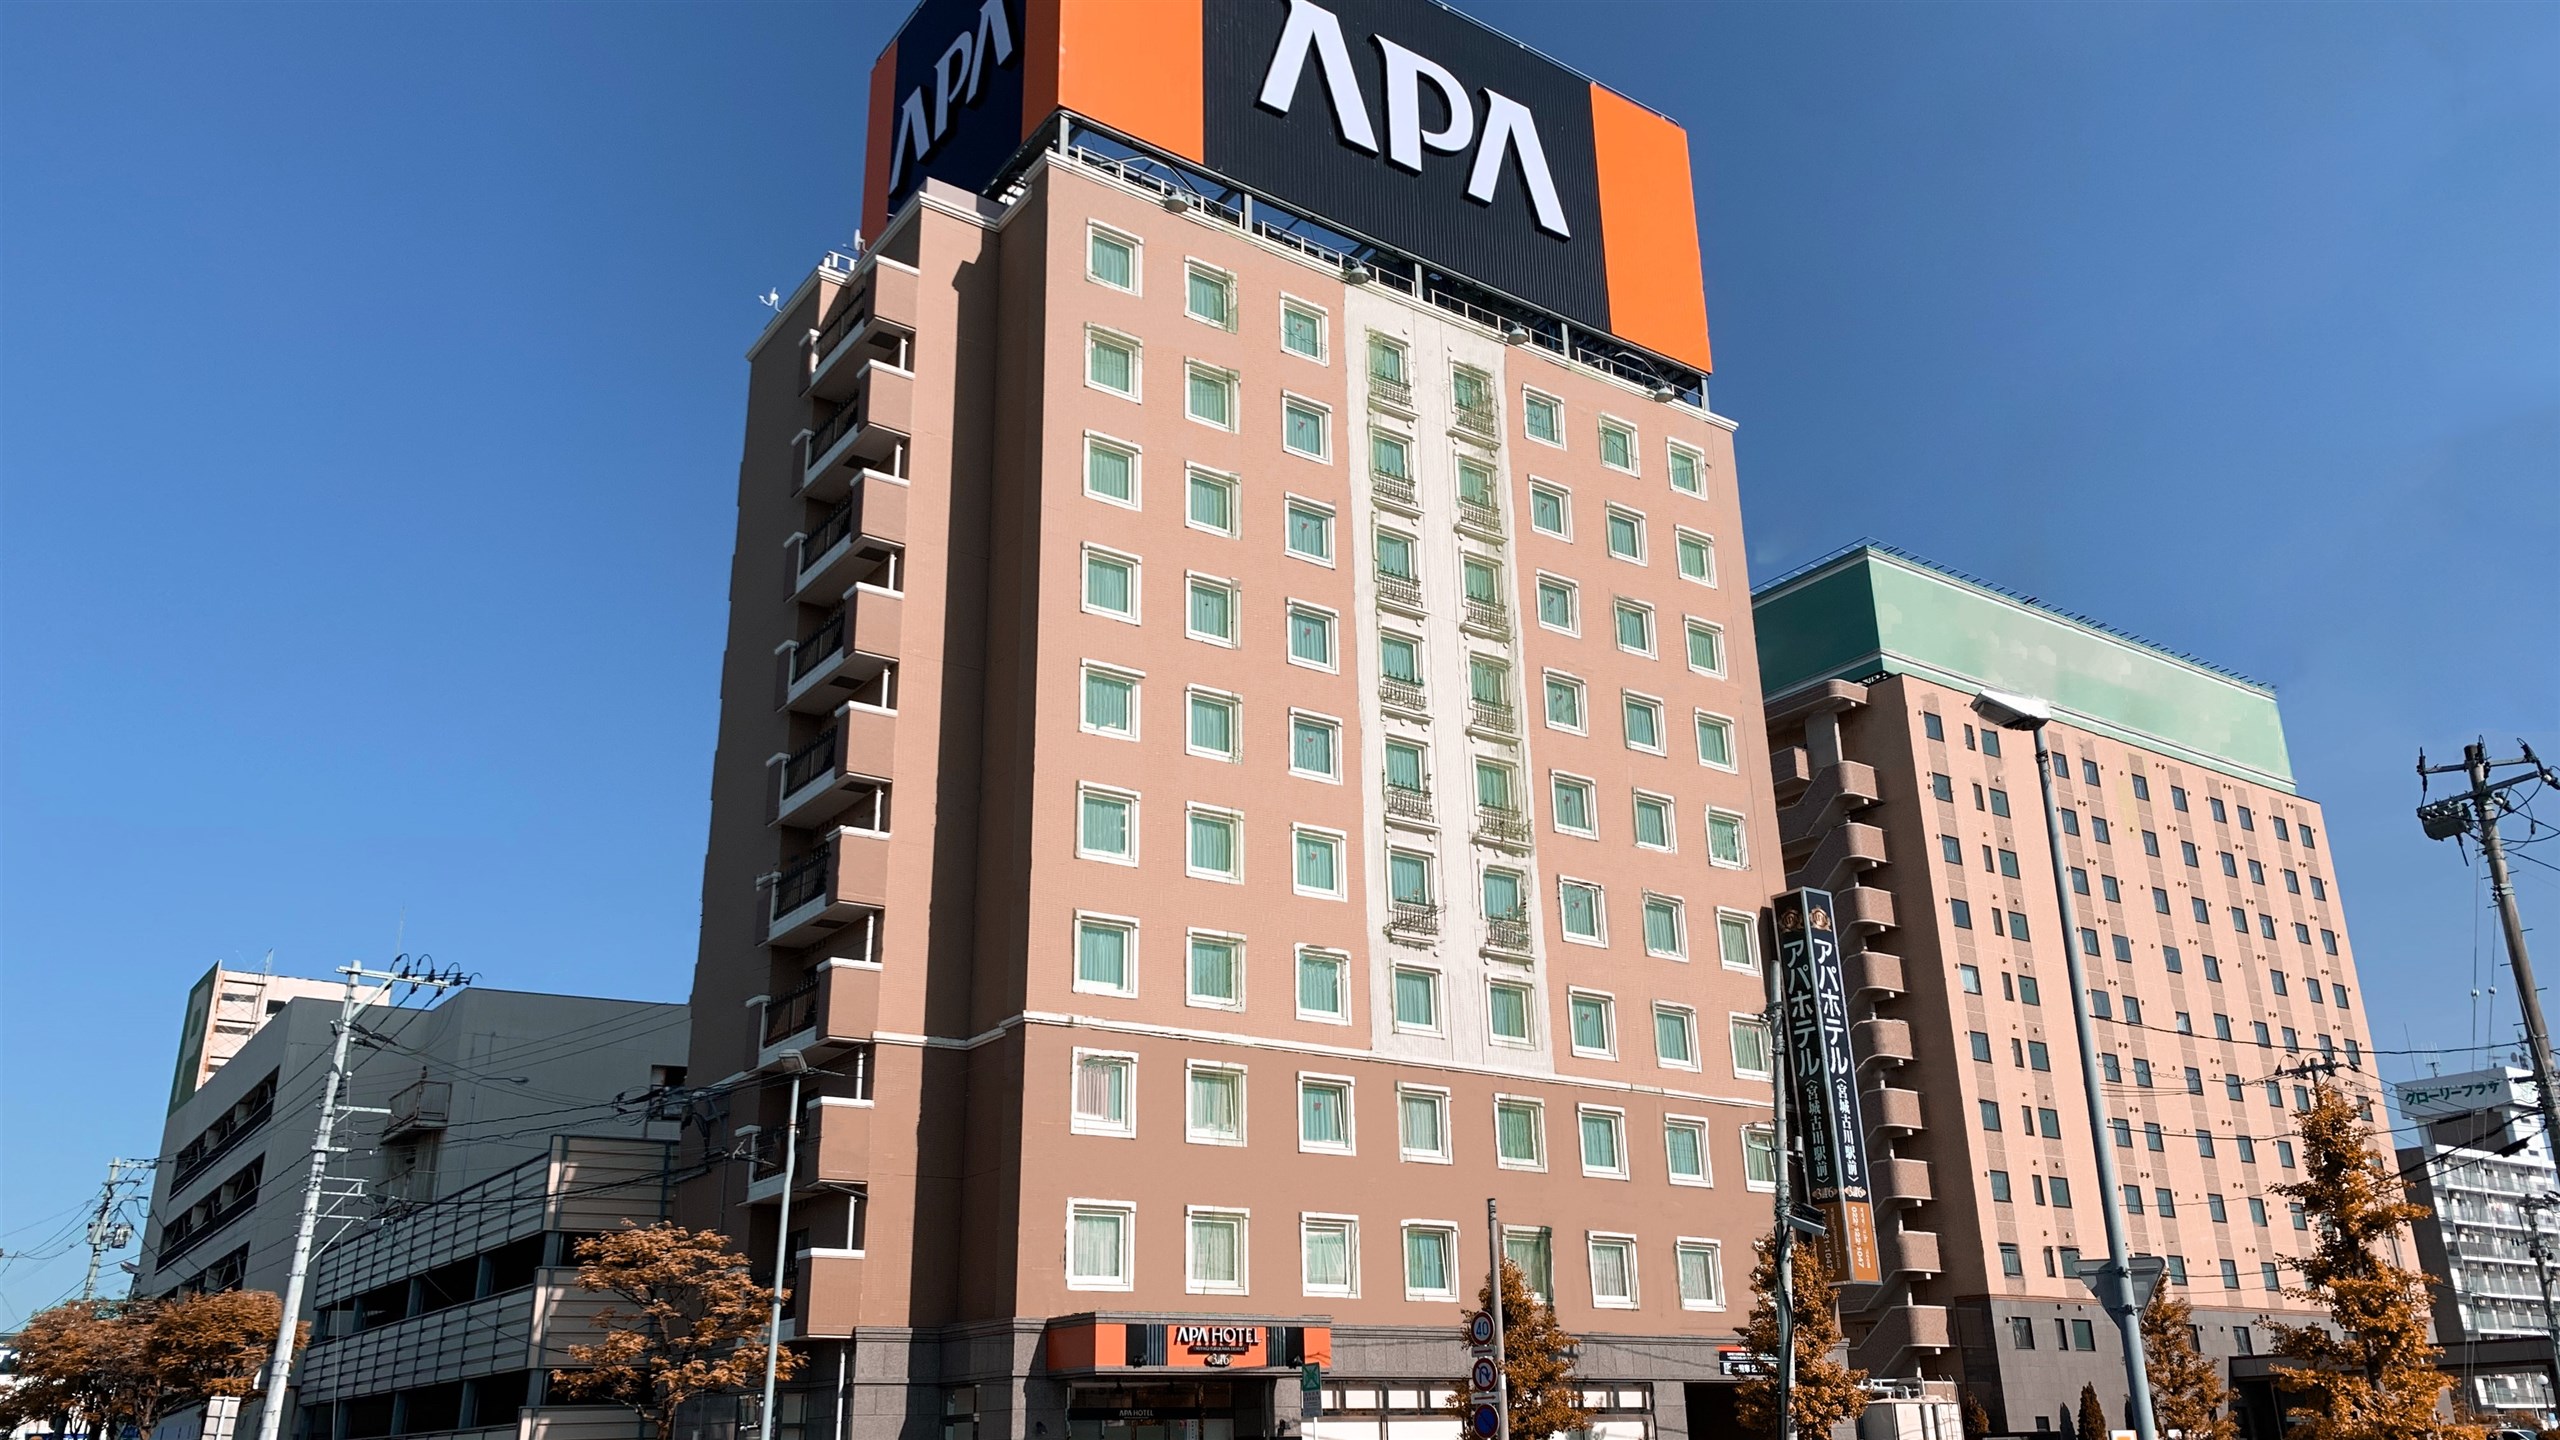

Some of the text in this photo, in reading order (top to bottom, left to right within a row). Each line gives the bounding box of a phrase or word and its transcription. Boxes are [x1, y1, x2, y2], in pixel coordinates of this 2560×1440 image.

[889, 0, 1012, 196] APA
[1260, 0, 1571, 238] APA
[1783, 938, 1820, 1077] アパホテル
[1813, 938, 1848, 1075] アパホテル
[1177, 1326, 1261, 1343] APA HOTEL
[1476, 1320, 1489, 1336] 40
[1133, 1409, 1154, 1417] HOTEL
